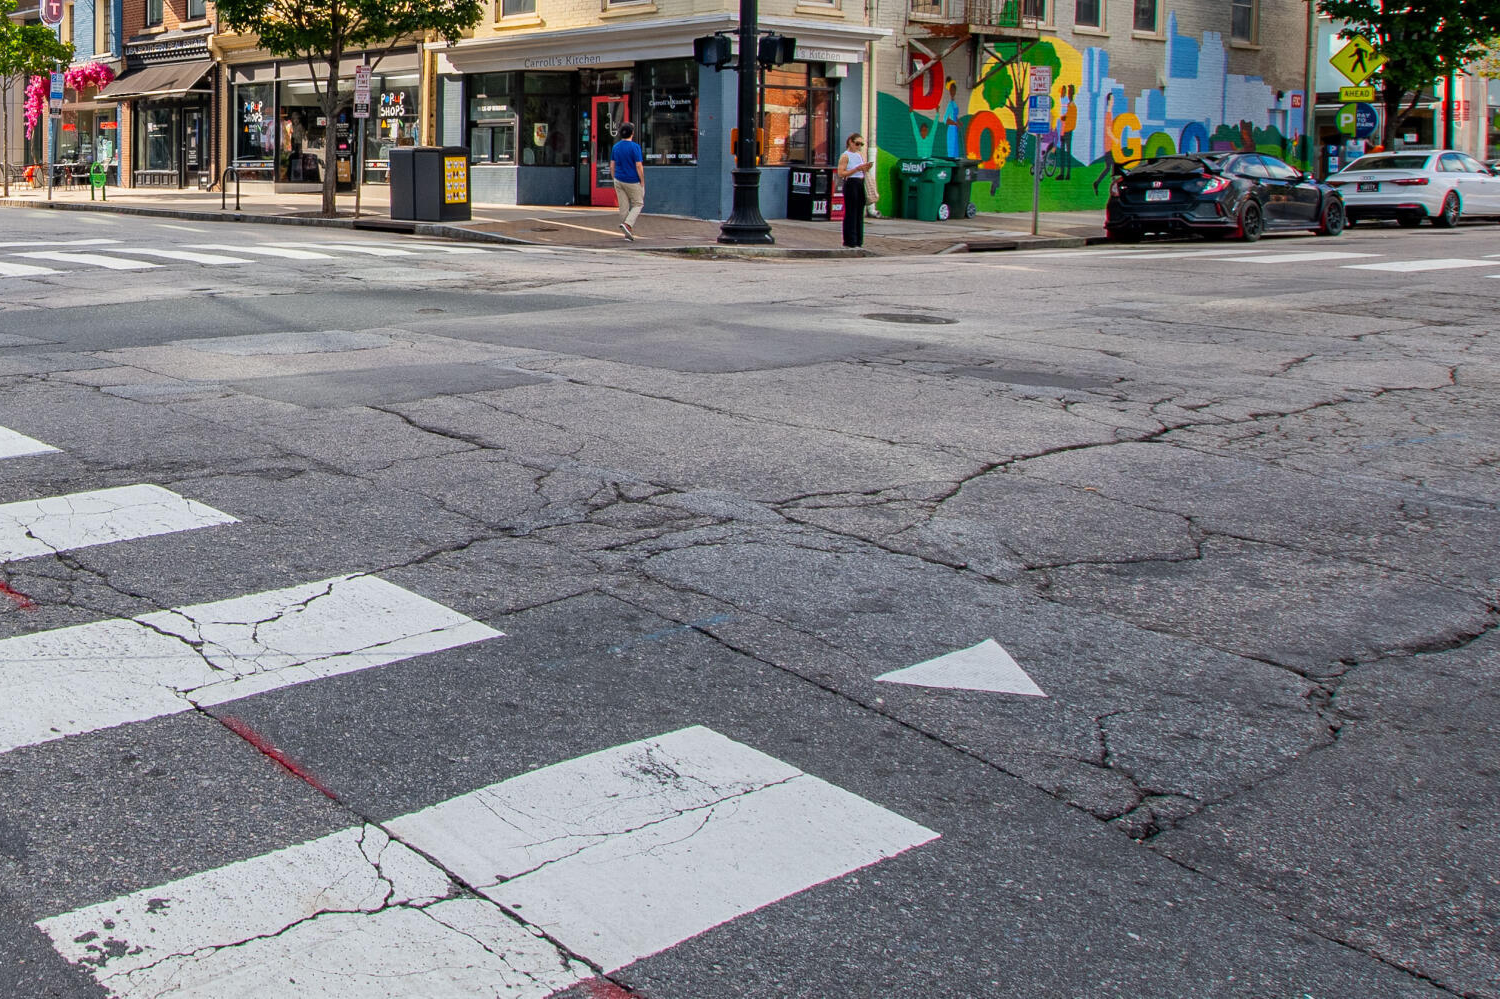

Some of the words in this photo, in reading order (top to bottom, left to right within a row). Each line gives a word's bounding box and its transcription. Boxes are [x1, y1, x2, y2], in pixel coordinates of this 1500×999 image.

[524, 56, 562, 68] Carroll's
[565, 54, 601, 66] Kitchen
[809, 49, 841, 61] Kitchen
[244, 112, 262, 122] SHOPS
[381, 105, 404, 117] SHOPS
[1340, 113, 1354, 128] P
[1330, 145, 1336, 154] P
